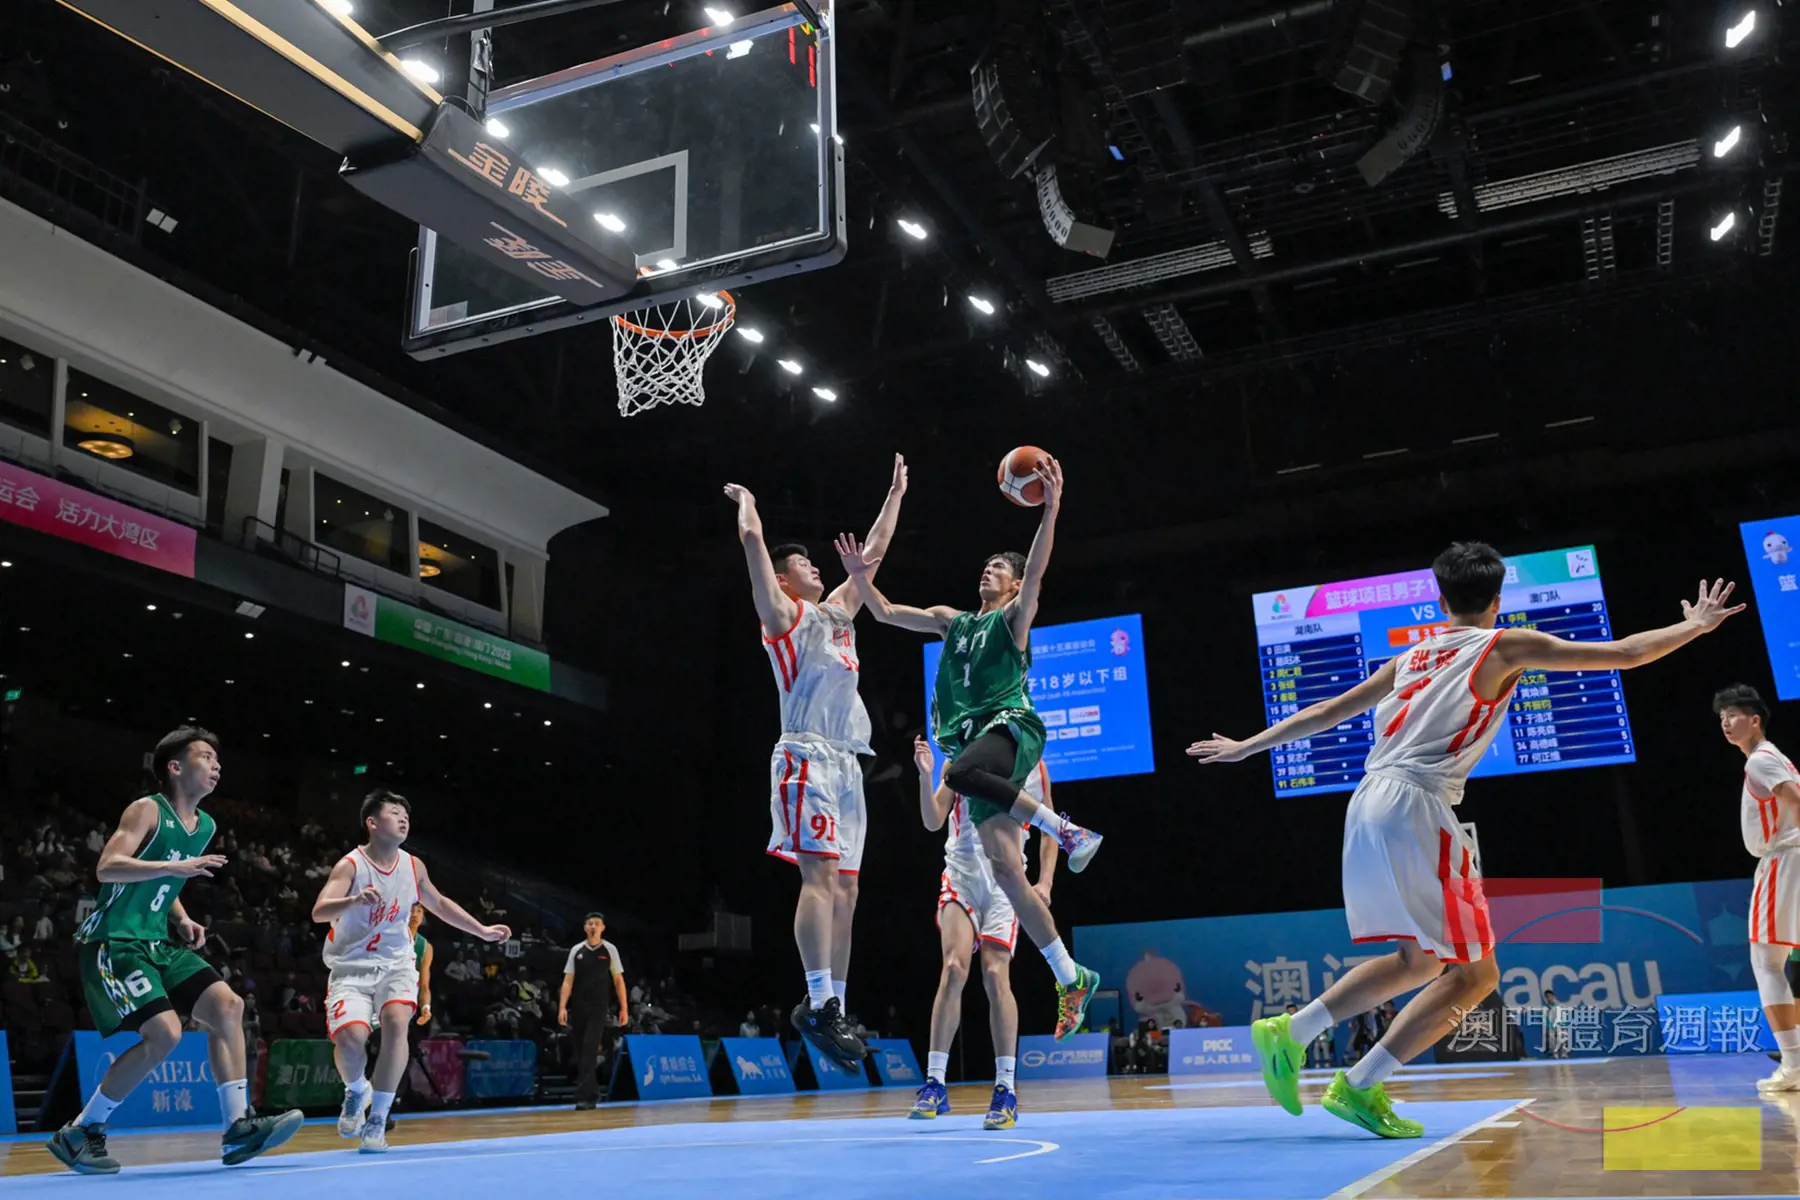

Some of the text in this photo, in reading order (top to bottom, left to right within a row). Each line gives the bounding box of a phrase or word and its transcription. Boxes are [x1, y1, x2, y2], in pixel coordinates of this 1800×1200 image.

[448, 142, 568, 228] 金陵
[55, 497, 161, 550] 活力大湾区
[1411, 604, 1436, 621] VS
[962, 662, 971, 688] 1
[810, 814, 836, 842] 91
[150, 884, 171, 912] 6
[365, 932, 381, 952] 2
[124, 969, 153, 998] 6
[1500, 959, 1663, 1010] acau
[333, 999, 348, 1020] 2
[1202, 1039, 1233, 1053] PICC
[148, 1060, 215, 1084] MELC
[277, 1064, 310, 1085] 澳门
[152, 1088, 194, 1112] 新濠
